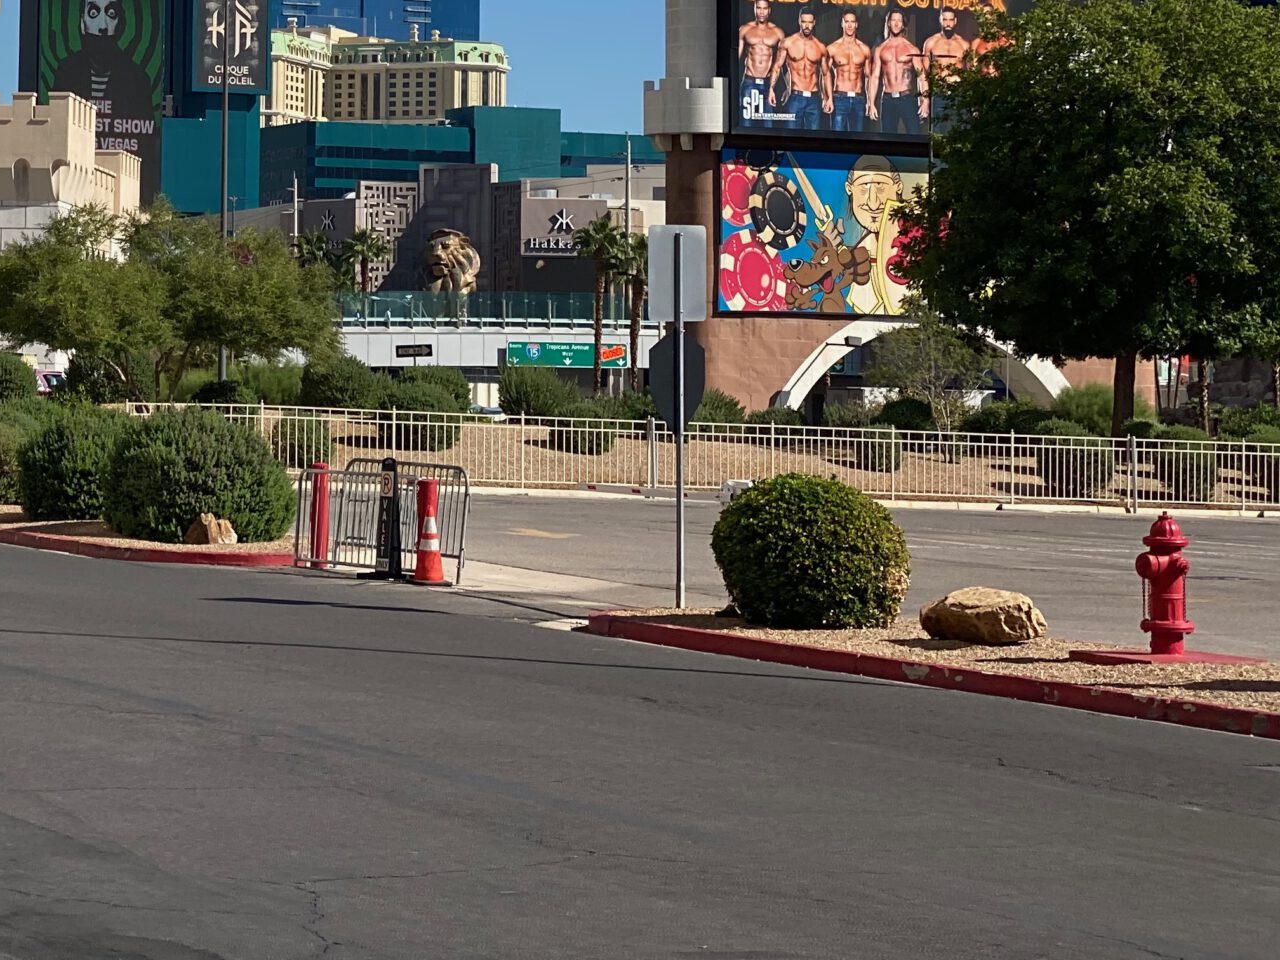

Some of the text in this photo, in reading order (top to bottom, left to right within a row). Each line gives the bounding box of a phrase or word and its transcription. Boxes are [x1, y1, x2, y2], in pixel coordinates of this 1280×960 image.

[208, 76, 256, 86] DU OLEIL
[90, 99, 112, 114] HE
[113, 118, 154, 135] SHOW
[100, 136, 139, 151] VEGAS
[529, 348, 538, 358] 15
[545, 343, 570, 351] Tropicana
[380, 499, 389, 557] VALET
